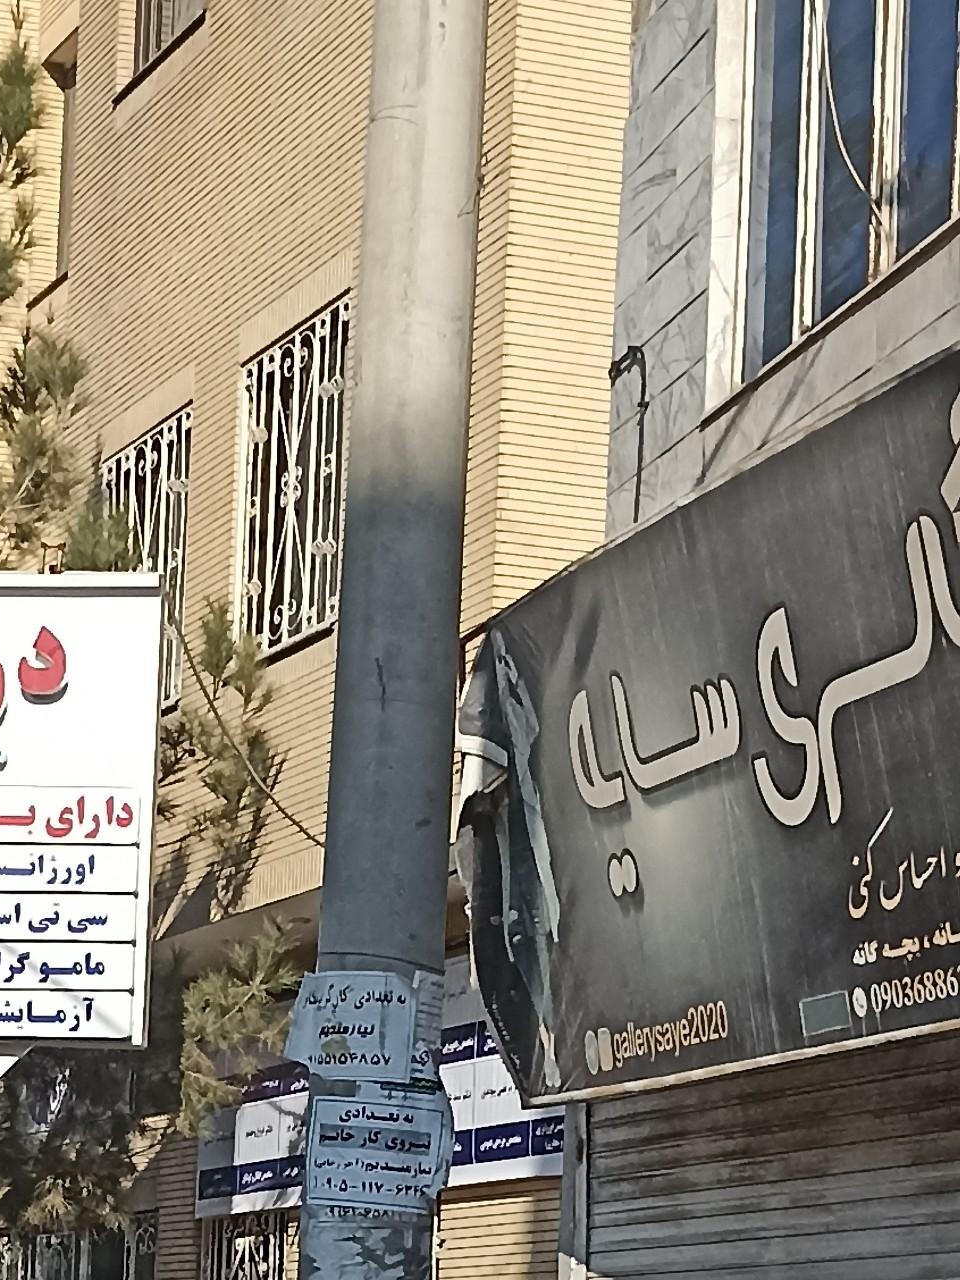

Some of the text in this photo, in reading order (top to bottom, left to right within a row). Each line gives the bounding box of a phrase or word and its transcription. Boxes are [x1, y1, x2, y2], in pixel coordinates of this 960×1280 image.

[569, 395, 960, 897] الری سایه
[45, 795, 134, 838] دارای
[28, 902, 60, 933] تی
[67, 914, 108, 933] سی
[870, 968, 960, 1014] 09036886
[614, 1000, 728, 1068] gallerysaye2020
